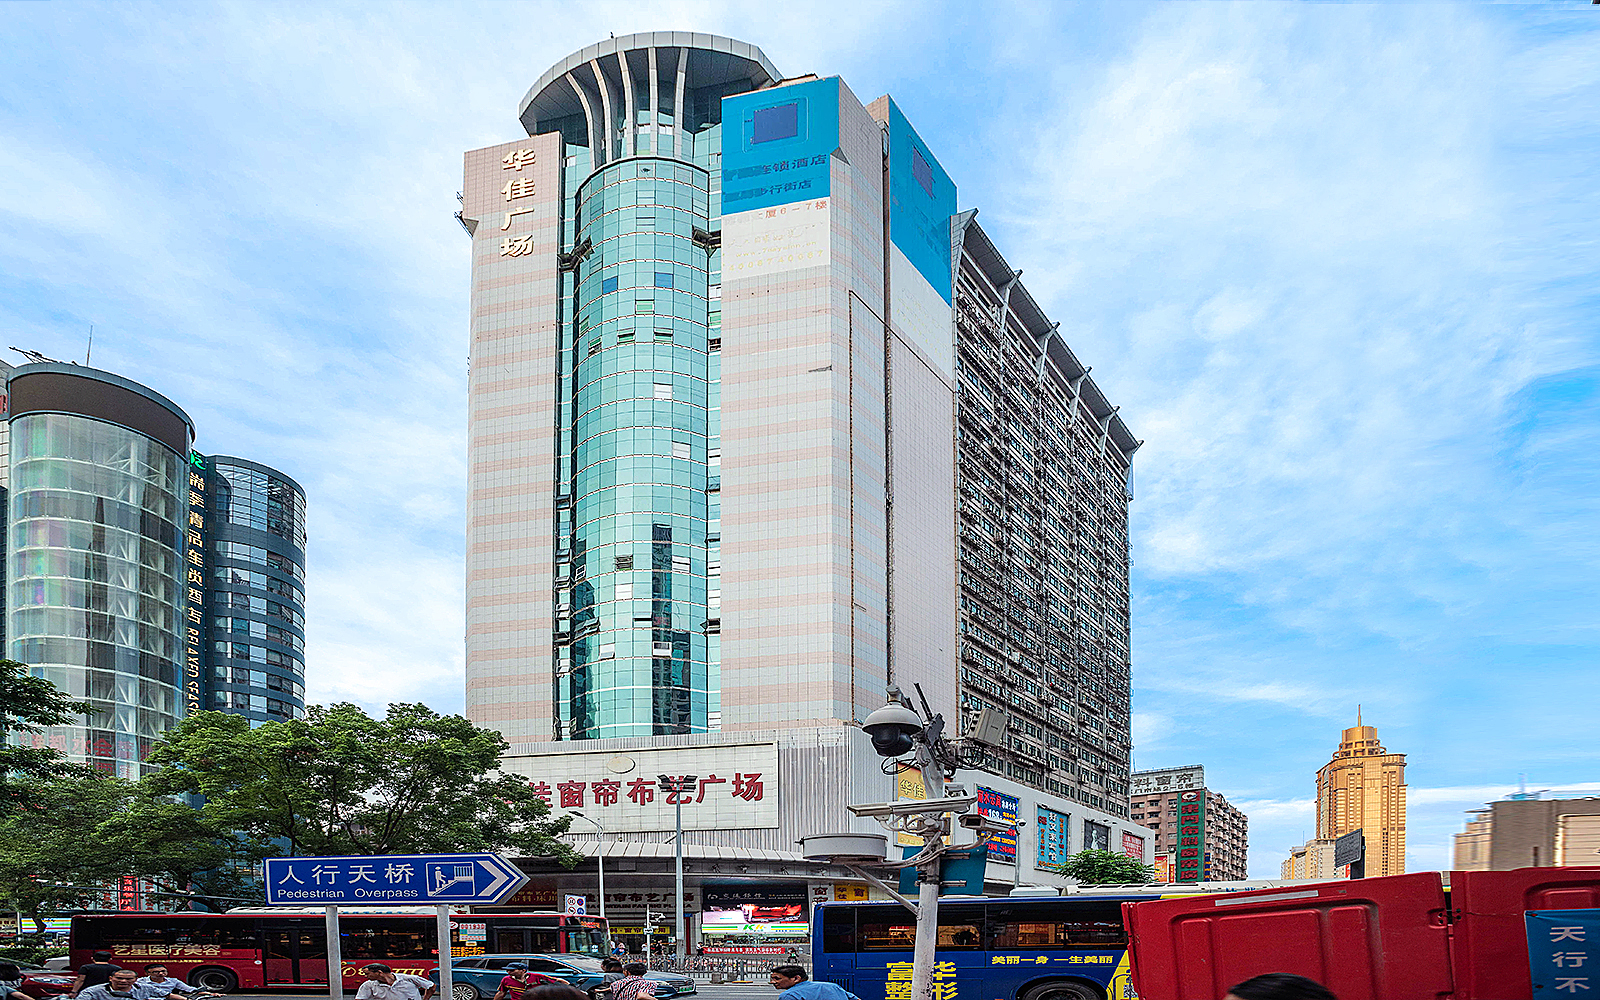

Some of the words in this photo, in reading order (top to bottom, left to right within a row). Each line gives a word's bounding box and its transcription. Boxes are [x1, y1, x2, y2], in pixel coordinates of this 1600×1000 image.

[501, 149, 535, 257] 华佳广场
[278, 863, 415, 885] 人行天桥
[278, 889, 345, 899] Pedestrian
[354, 888, 418, 899] Overpass
[112, 944, 220, 956] 艺星医疗美容
[991, 955, 1049, 964] 美丽一身
[1054, 955, 1114, 964] 一生美丽
